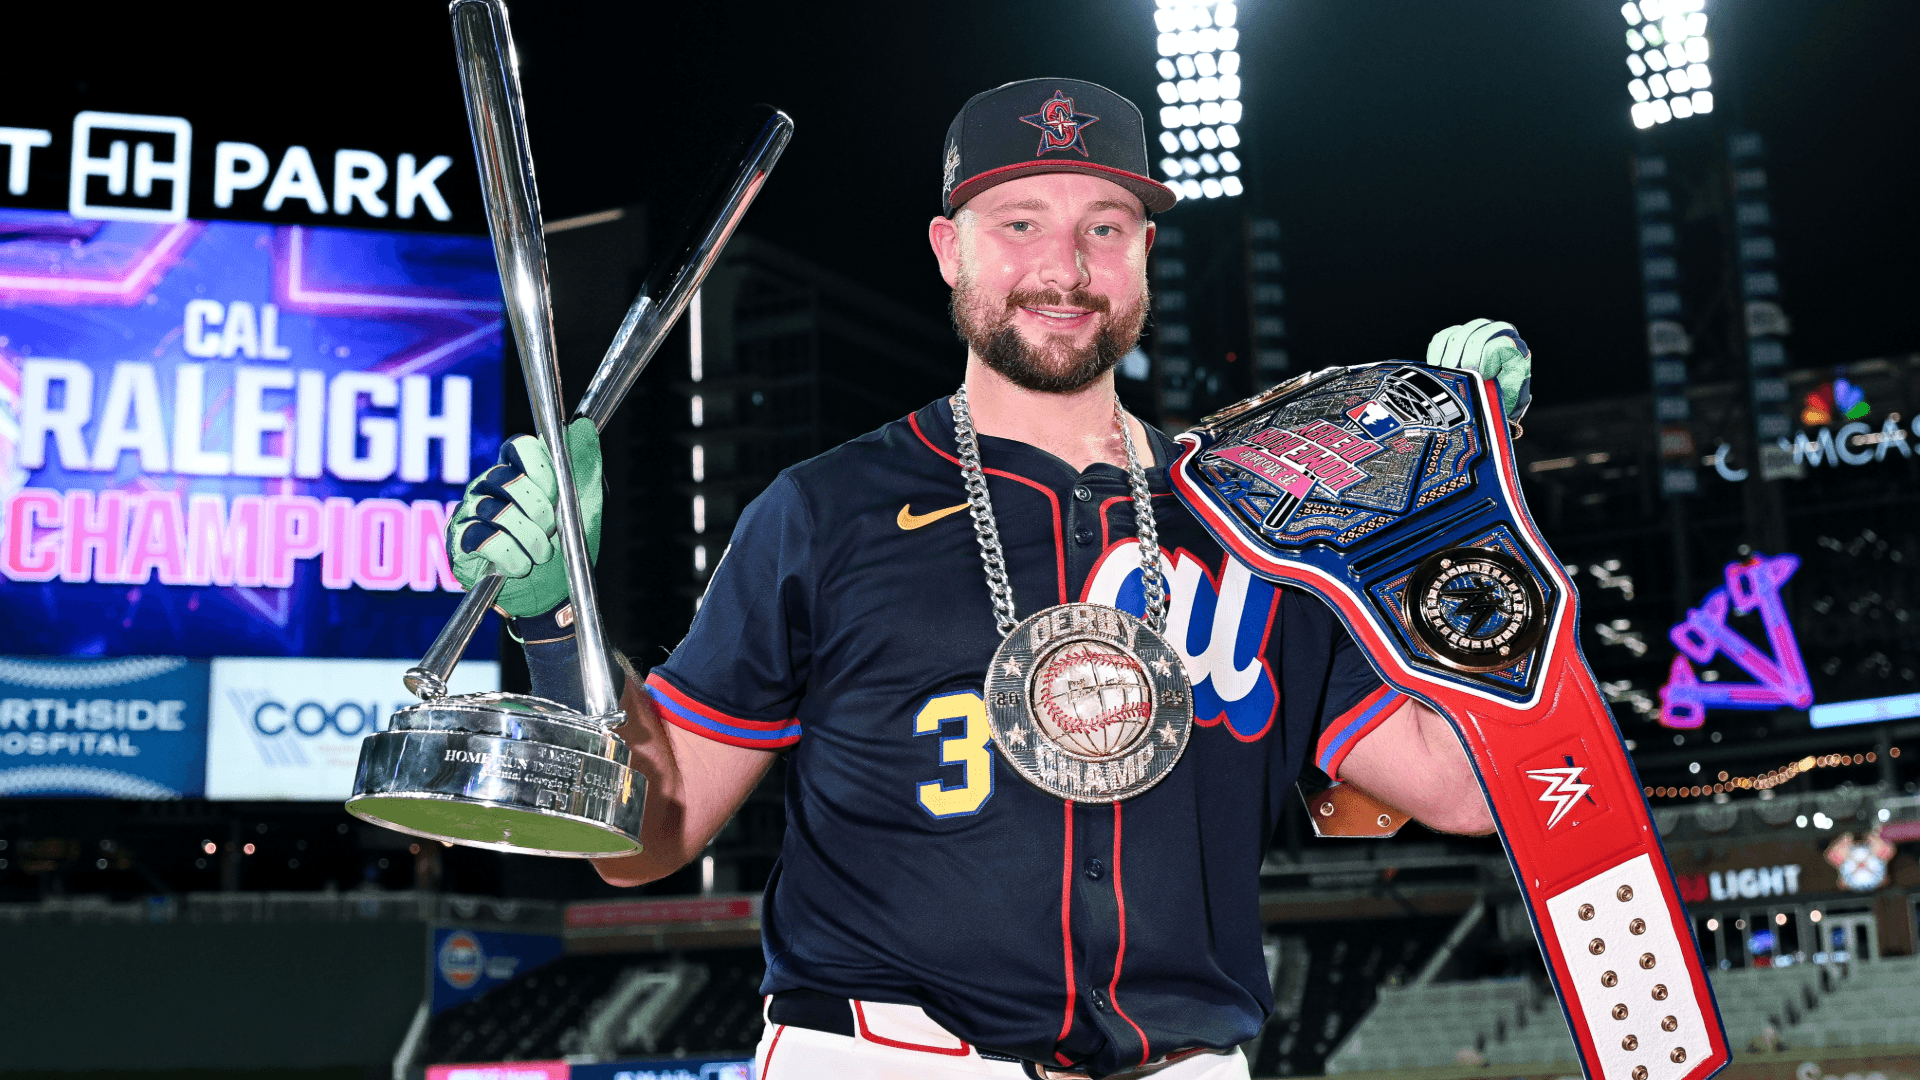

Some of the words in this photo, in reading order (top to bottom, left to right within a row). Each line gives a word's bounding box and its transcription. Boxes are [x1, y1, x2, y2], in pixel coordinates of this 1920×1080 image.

[214, 142, 453, 221] PARK
[184, 299, 292, 361] CAL
[20, 357, 473, 484] RALEIGH
[1293, 419, 1380, 464] DERBY
[1714, 413, 1920, 482] CMCA
[0, 489, 467, 592] CHAMPION
[1030, 606, 1140, 653] DERBY
[254, 700, 415, 737] COOL
[995, 691, 1020, 707] 20
[444, 749, 491, 764] HOME
[912, 688, 996, 820] 3
[1036, 742, 1155, 794] CHAMP
[1709, 864, 1801, 901] LIGHT
